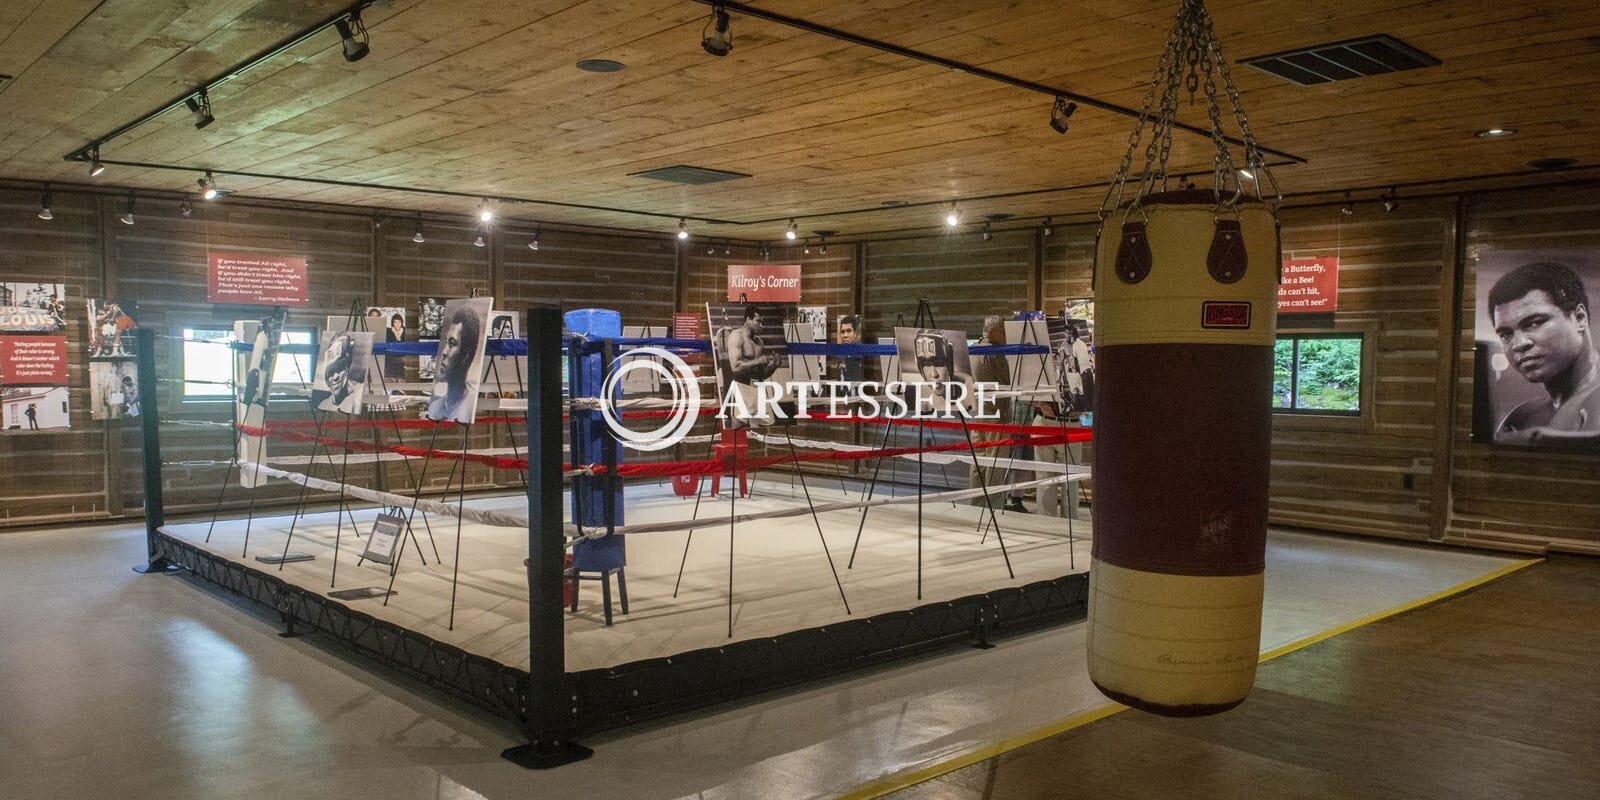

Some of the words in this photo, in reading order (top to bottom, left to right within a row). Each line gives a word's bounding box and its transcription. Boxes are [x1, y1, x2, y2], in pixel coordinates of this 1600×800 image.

[1290, 264, 1326, 274] Butterfly,
[731, 275, 766, 291] Kilroy's
[767, 275, 798, 288] Corner
[1281, 276, 1292, 284] ike
[1299, 276, 1314, 284] Bee!
[1307, 287, 1320, 295] hit,
[1277, 300, 1291, 309] yes
[1310, 298, 1328, 306] see!"
